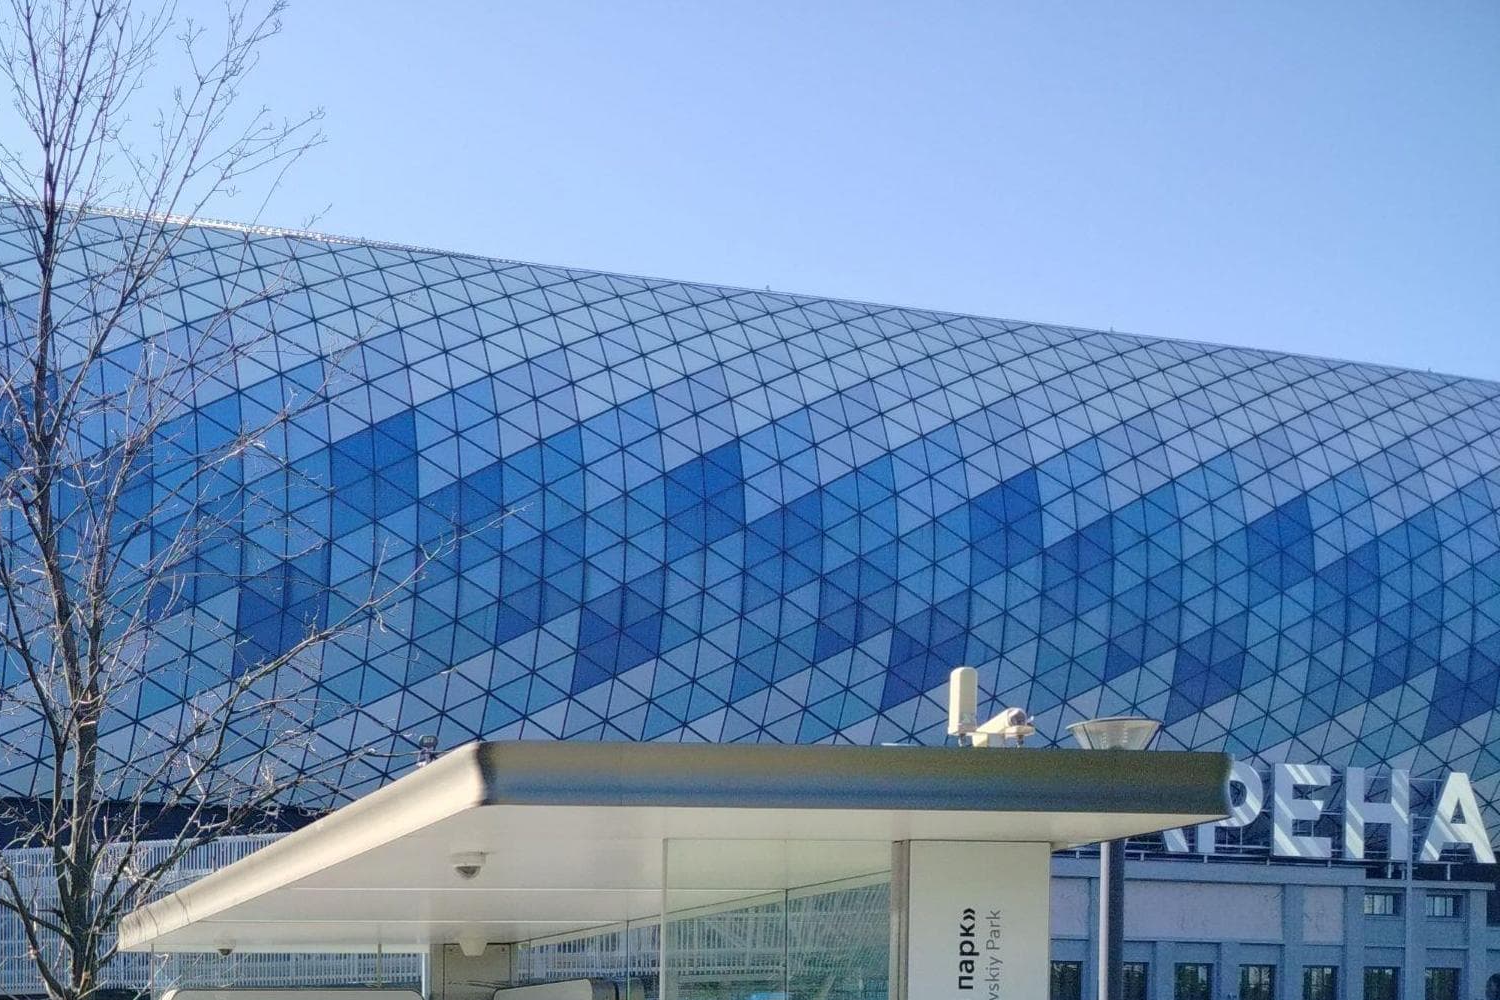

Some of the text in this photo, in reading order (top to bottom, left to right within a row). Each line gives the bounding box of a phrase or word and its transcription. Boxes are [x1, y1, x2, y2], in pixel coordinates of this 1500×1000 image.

[1124, 761, 1497, 864] РЕНА
[957, 907, 981, 990] парк»
[985, 909, 1002, 951] Park
